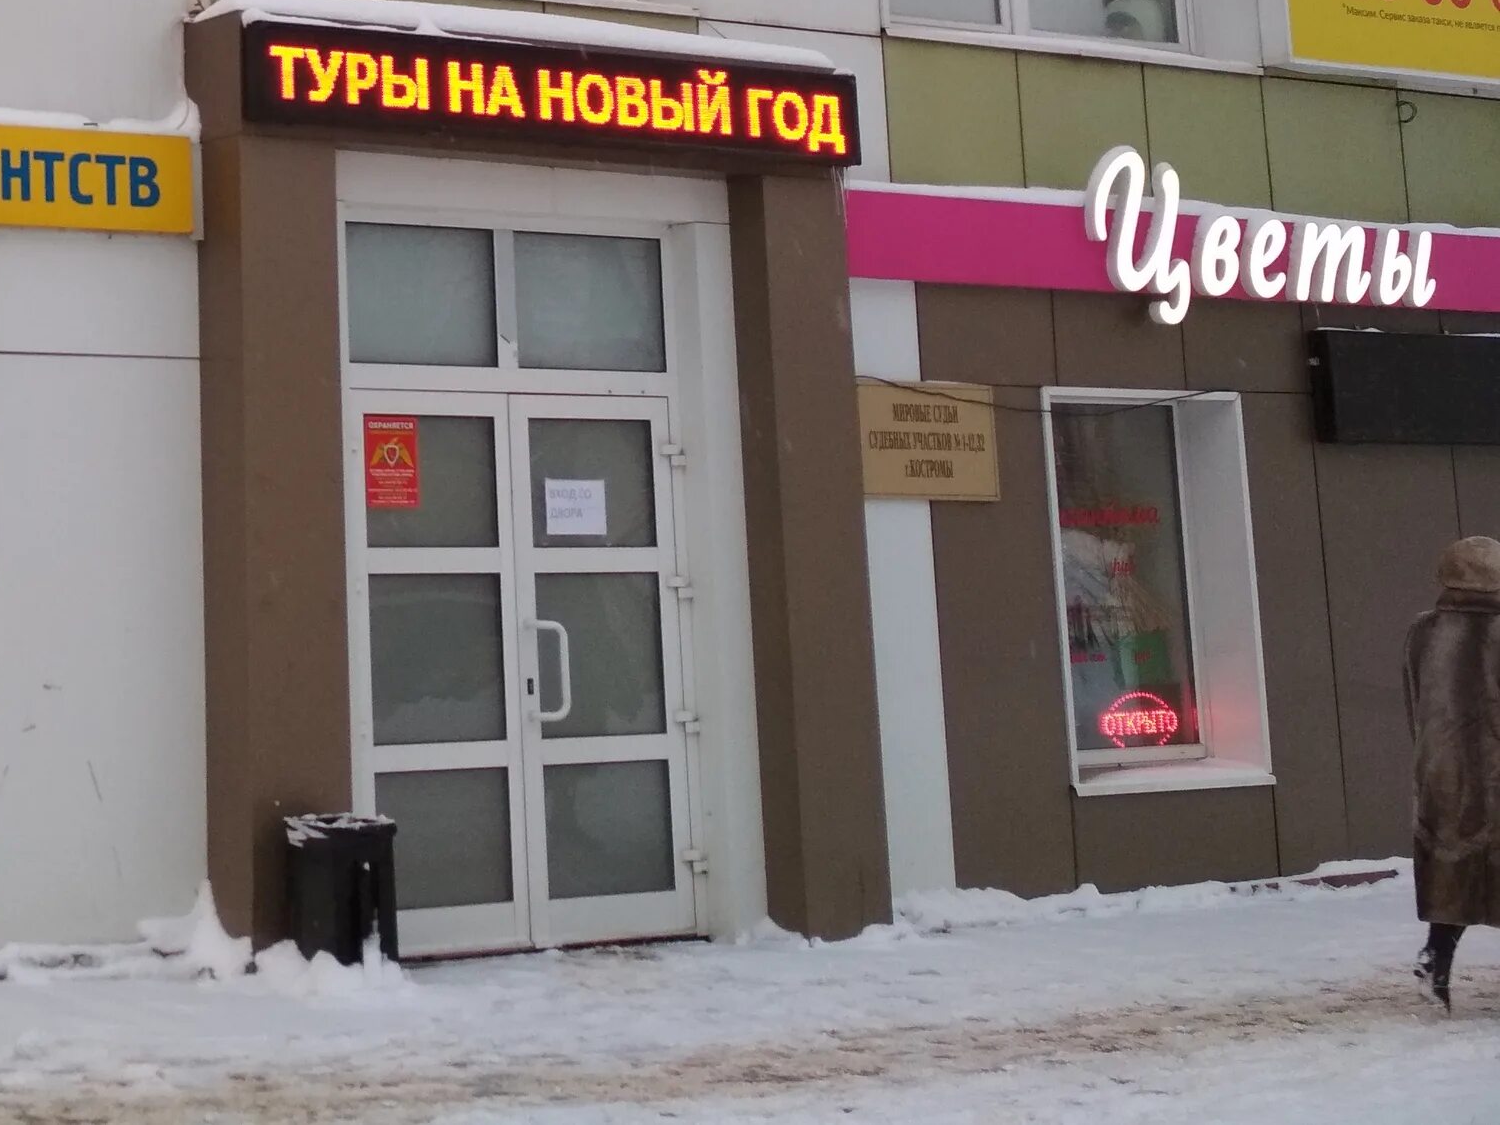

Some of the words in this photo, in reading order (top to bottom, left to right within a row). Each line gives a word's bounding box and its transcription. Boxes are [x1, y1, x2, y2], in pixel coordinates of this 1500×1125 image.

[268, 44, 429, 111] ТУРЫ
[447, 61, 526, 118] НА
[537, 68, 734, 137] НОВЫЙ
[746, 88, 847, 155] ГОД
[1085, 145, 1436, 325] Цветы
[892, 403, 931, 423] МИРОВЫЕ
[933, 405, 958, 424] СУДЬИ
[868, 430, 911, 450] СУДЕБНЫХ
[912, 432, 951, 451] УЧАСТКОВ
[1101, 710, 1178, 735] ОТКРЫТО
